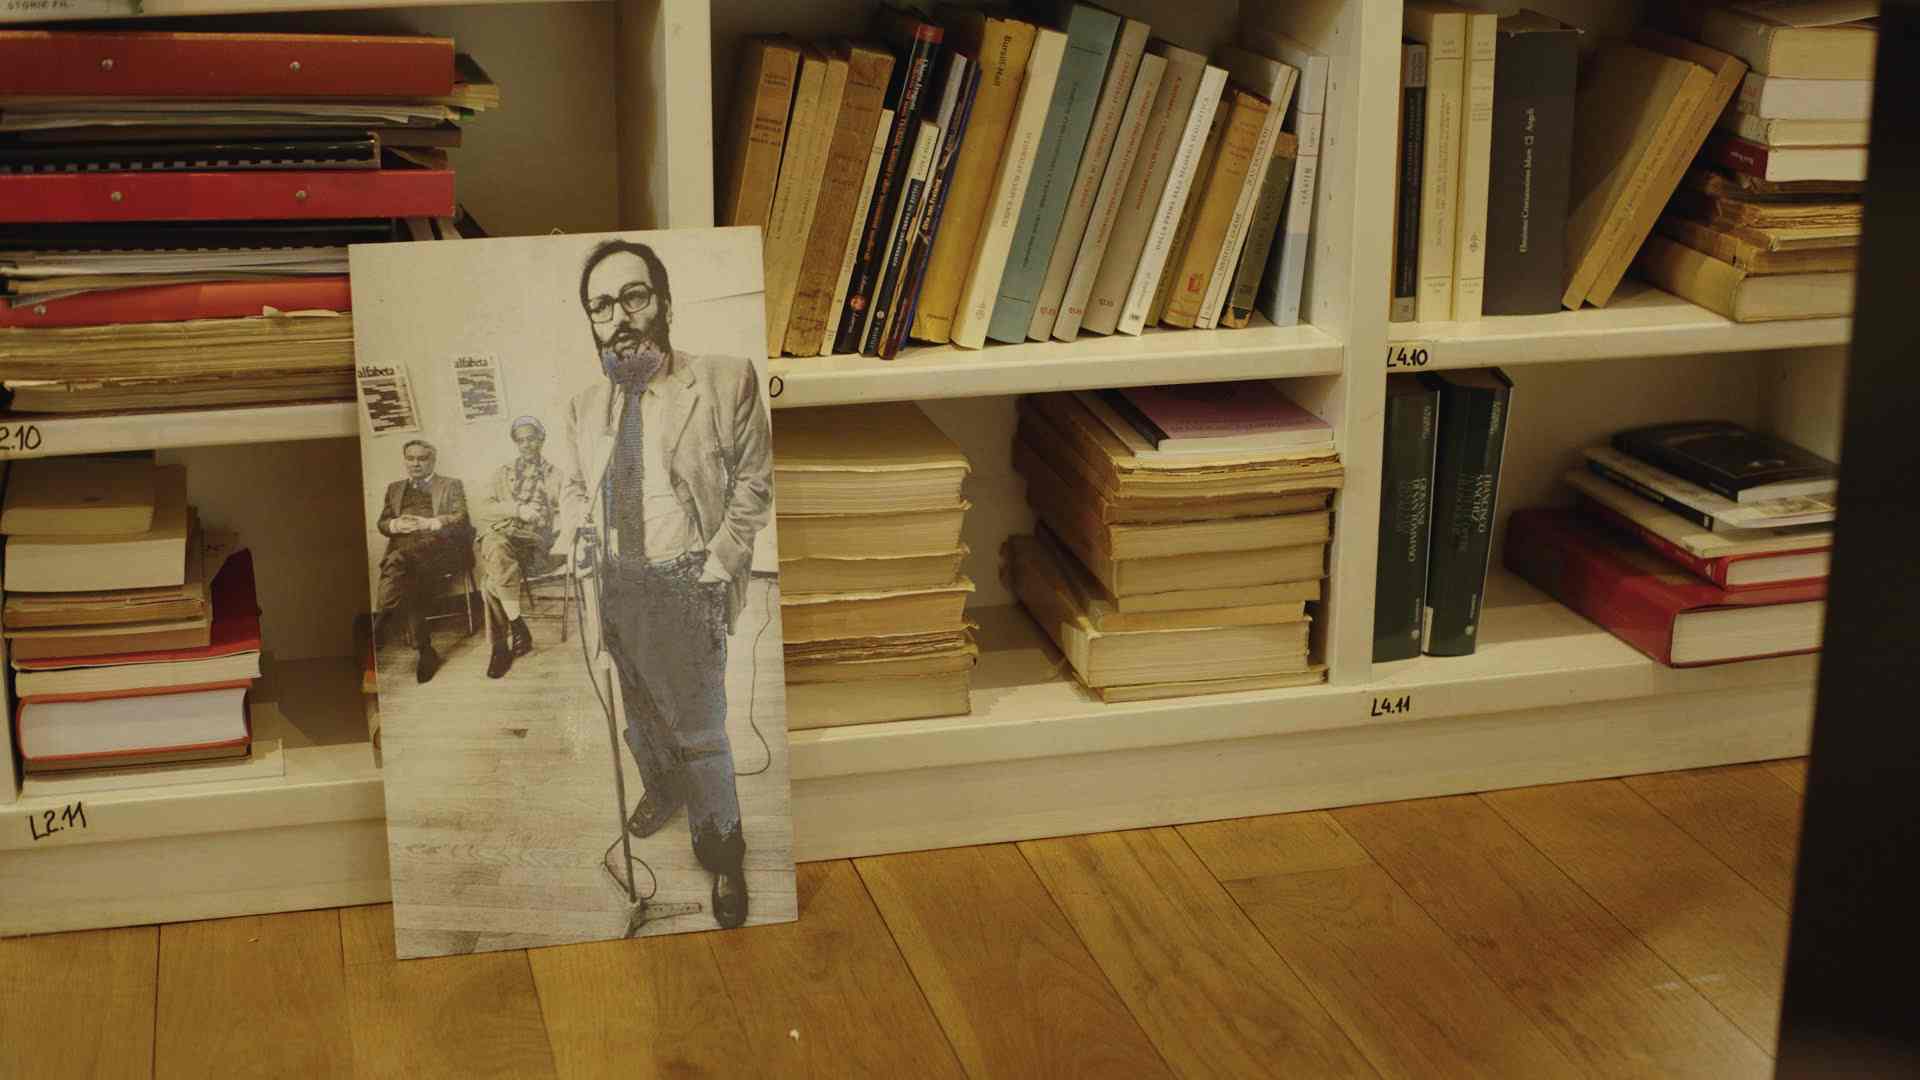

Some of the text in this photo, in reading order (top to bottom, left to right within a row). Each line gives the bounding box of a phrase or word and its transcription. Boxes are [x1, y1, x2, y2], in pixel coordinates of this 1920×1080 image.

[454, 357, 488, 369] alfabeta
[1387, 346, 1428, 368] L4.10
[357, 366, 395, 378] alfabeta
[1371, 695, 1410, 717] L4.11
[29, 800, 87, 841] L2.11
